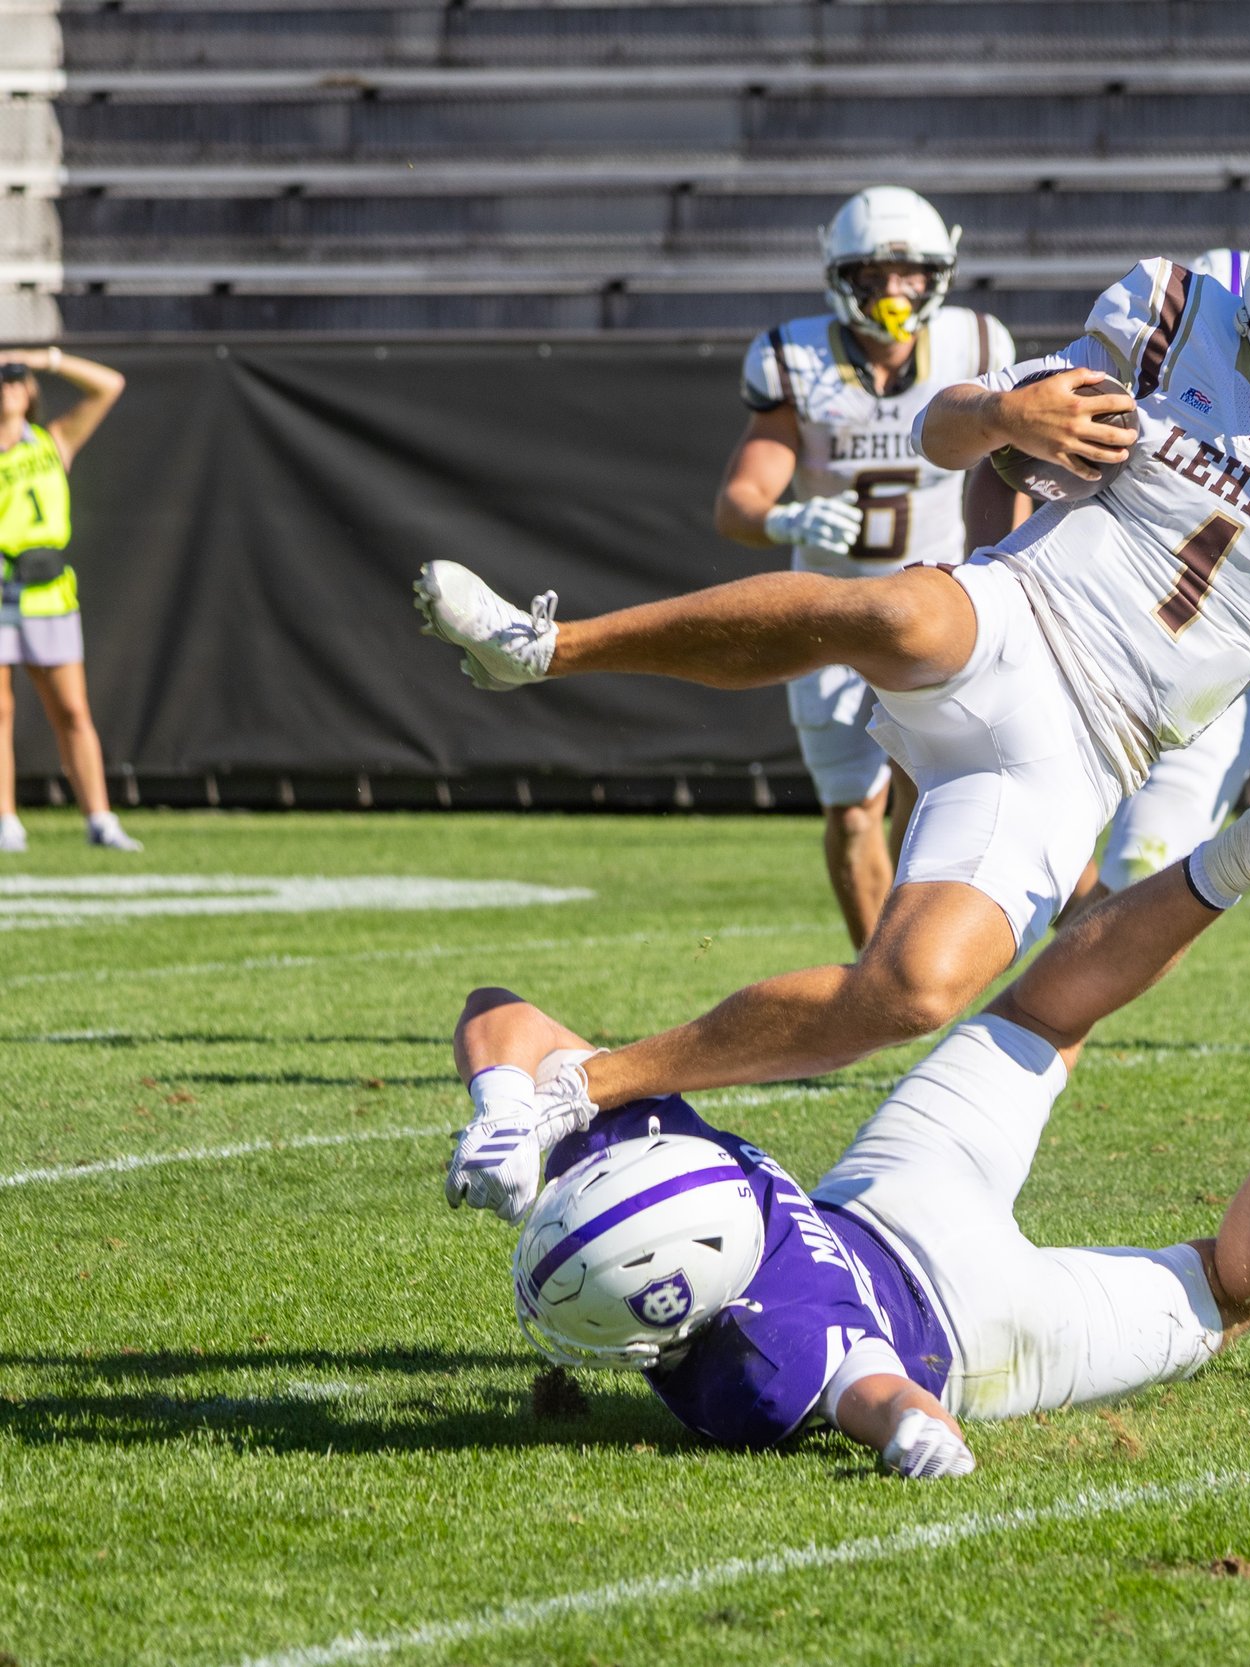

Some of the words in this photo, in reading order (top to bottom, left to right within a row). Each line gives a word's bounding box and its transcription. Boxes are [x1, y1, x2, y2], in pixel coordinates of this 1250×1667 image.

[27, 487, 44, 523] 1
[848, 466, 921, 562] 6
[1150, 508, 1247, 644] 1
